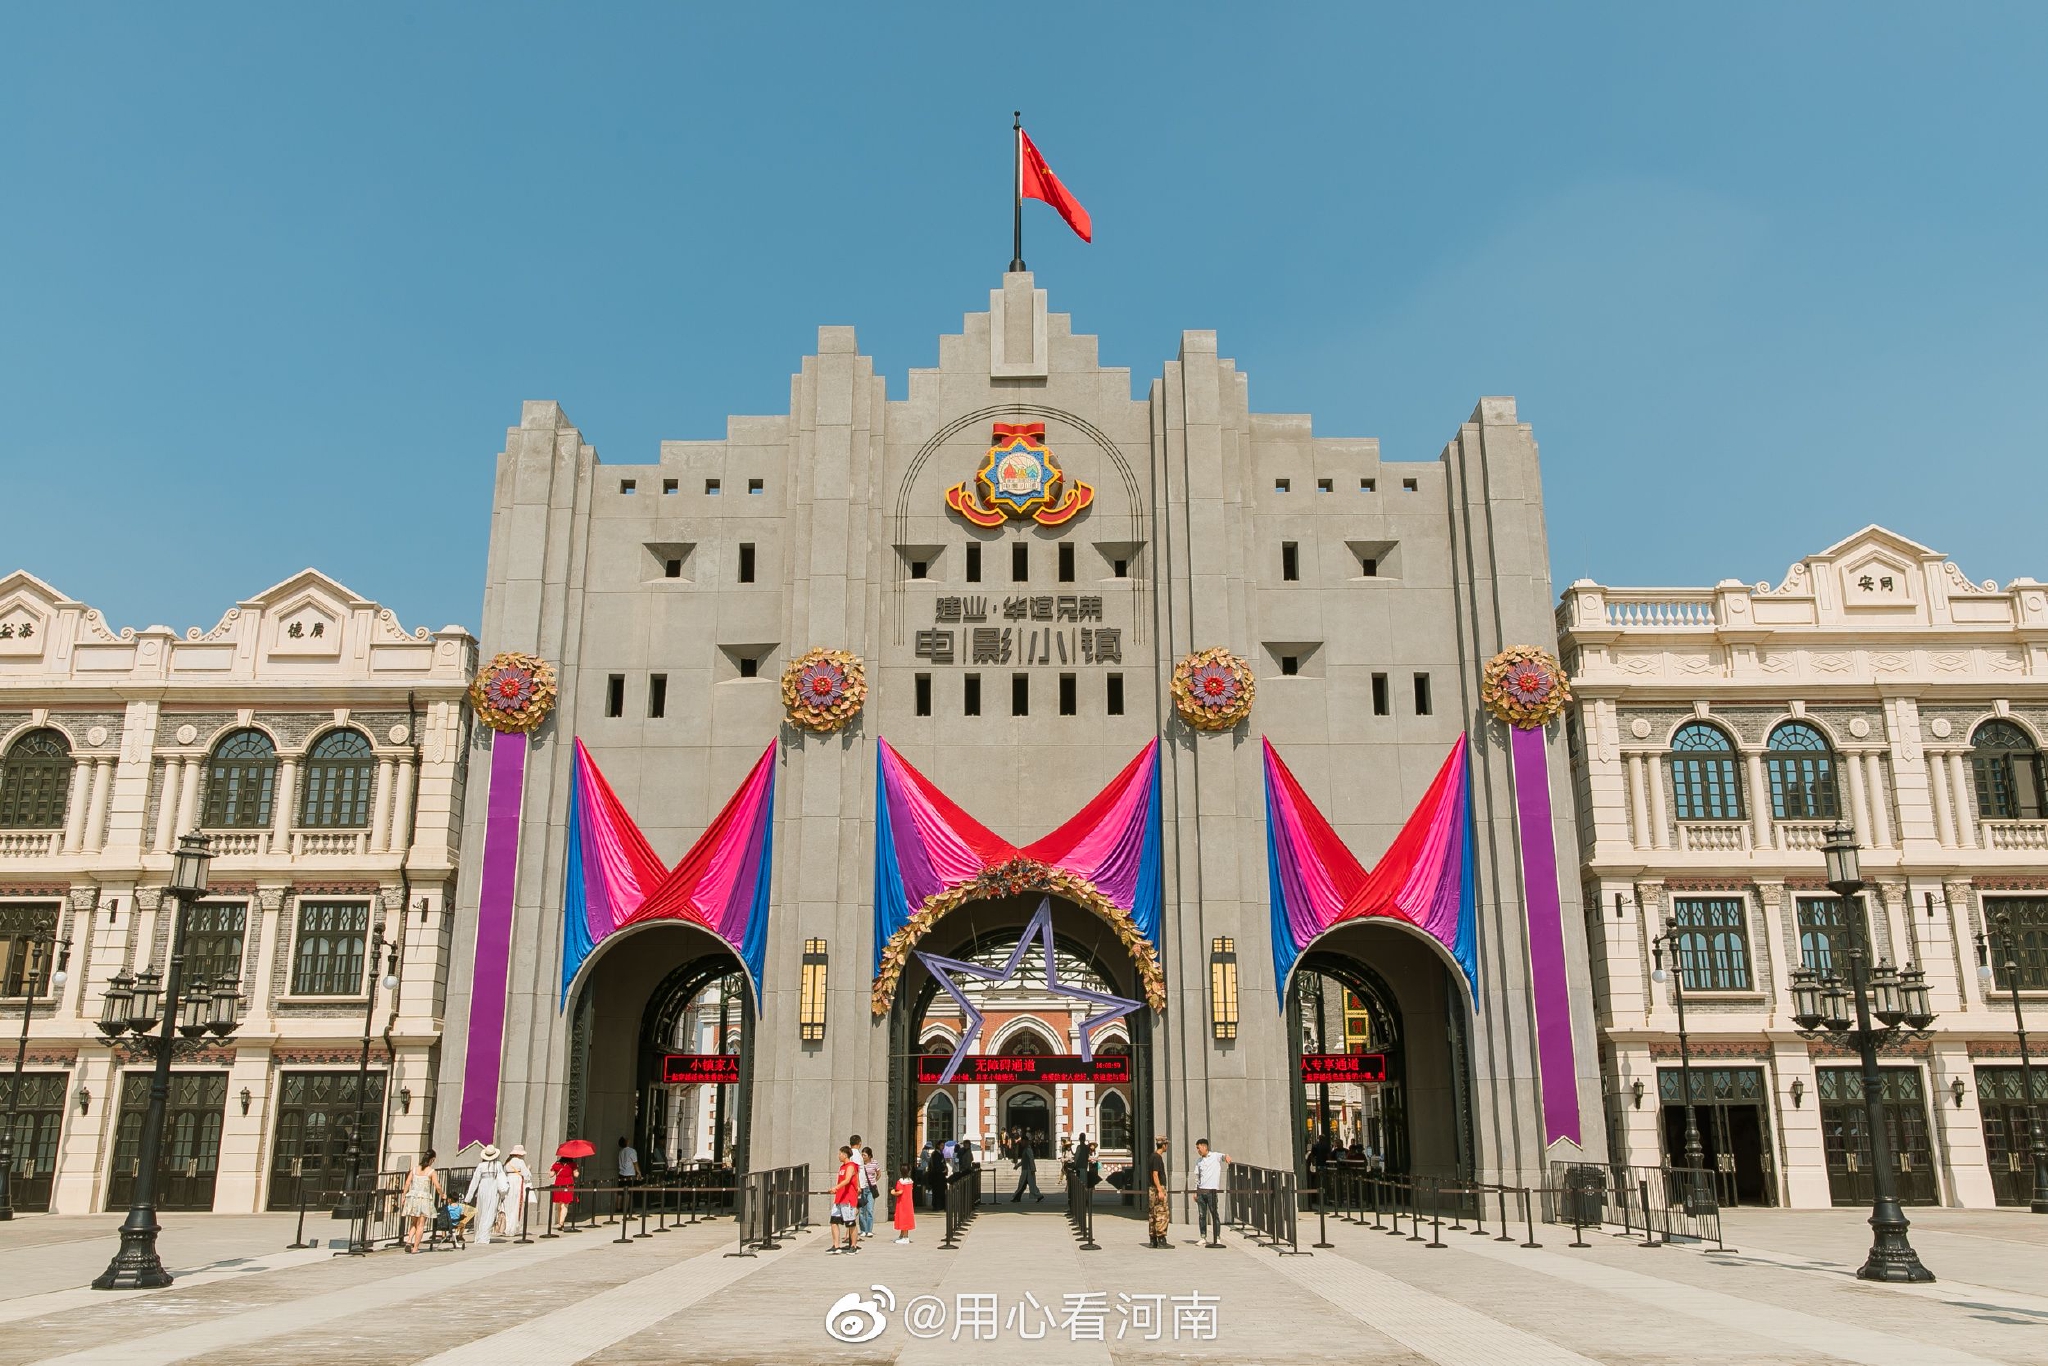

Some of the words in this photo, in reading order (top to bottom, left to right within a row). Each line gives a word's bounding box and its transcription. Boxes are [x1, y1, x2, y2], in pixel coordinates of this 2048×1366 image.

[975, 1059, 1036, 1072] 无障碍通道
